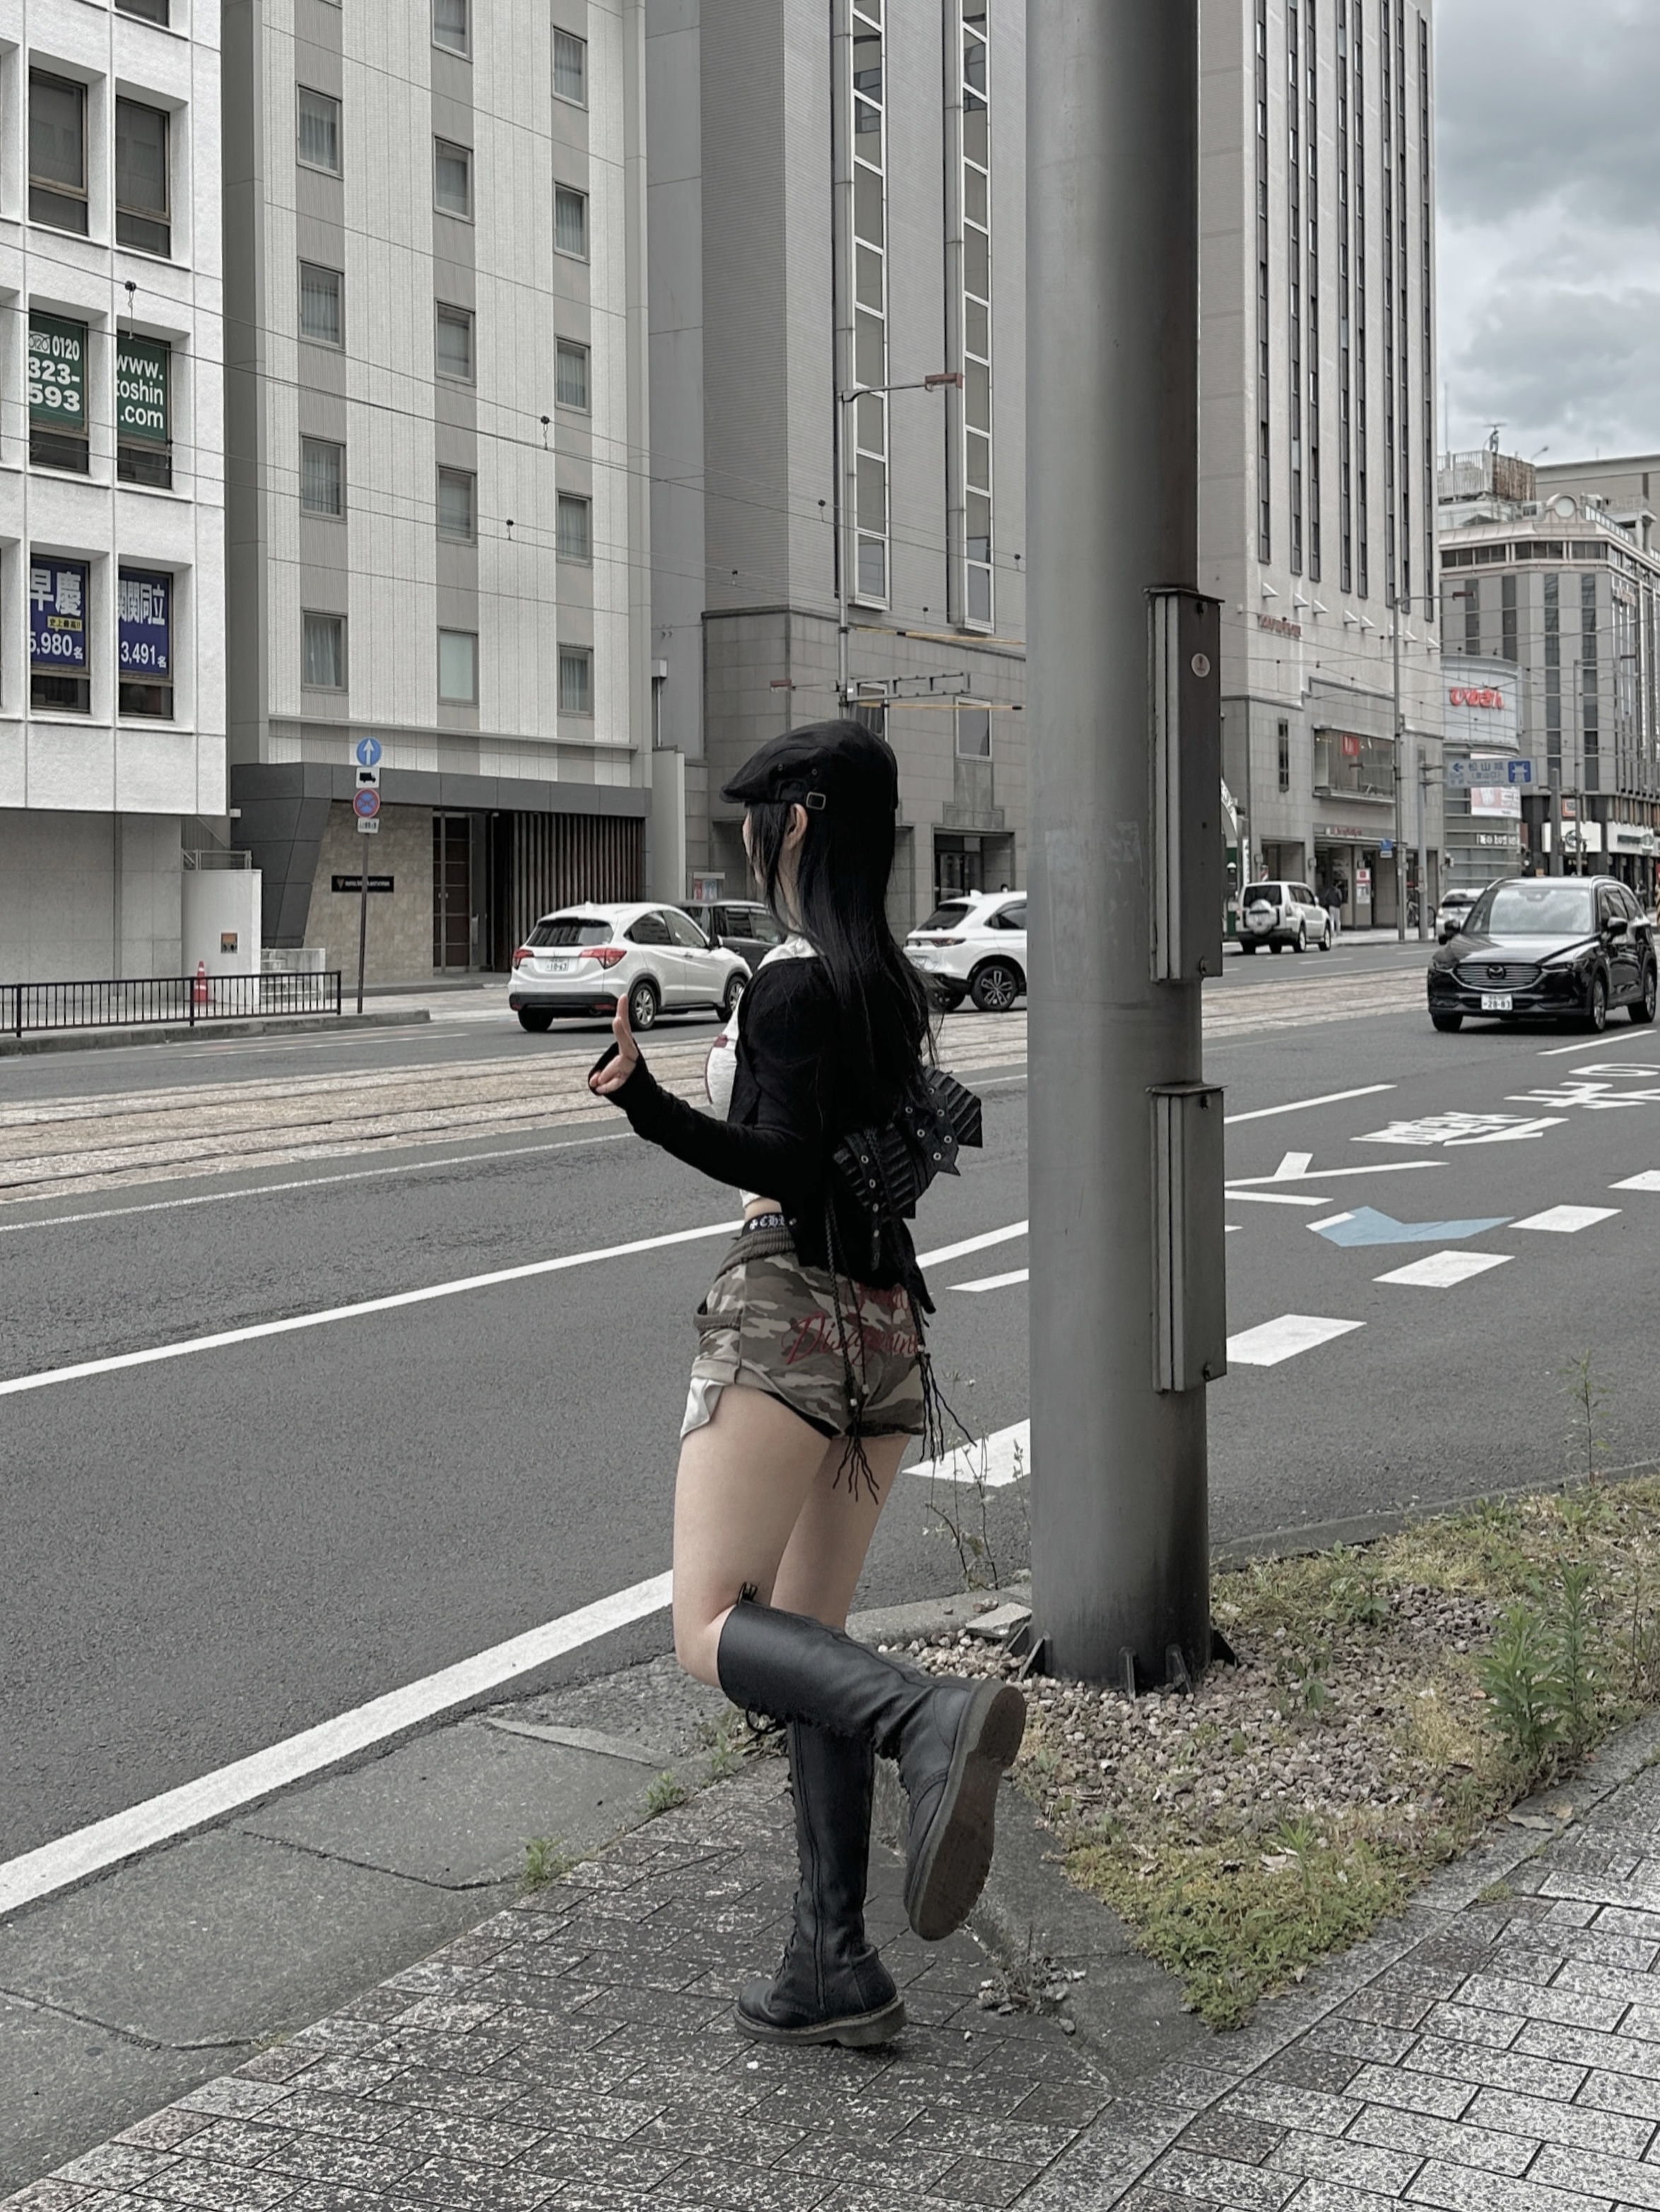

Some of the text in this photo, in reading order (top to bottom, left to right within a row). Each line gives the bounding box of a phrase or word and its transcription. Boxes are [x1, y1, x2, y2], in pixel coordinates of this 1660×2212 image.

[52, 335, 80, 361] 0120
[29, 356, 80, 385] 323-
[29, 382, 80, 412] 593
[120, 406, 163, 429] .com
[30, 568, 81, 617] 早慶
